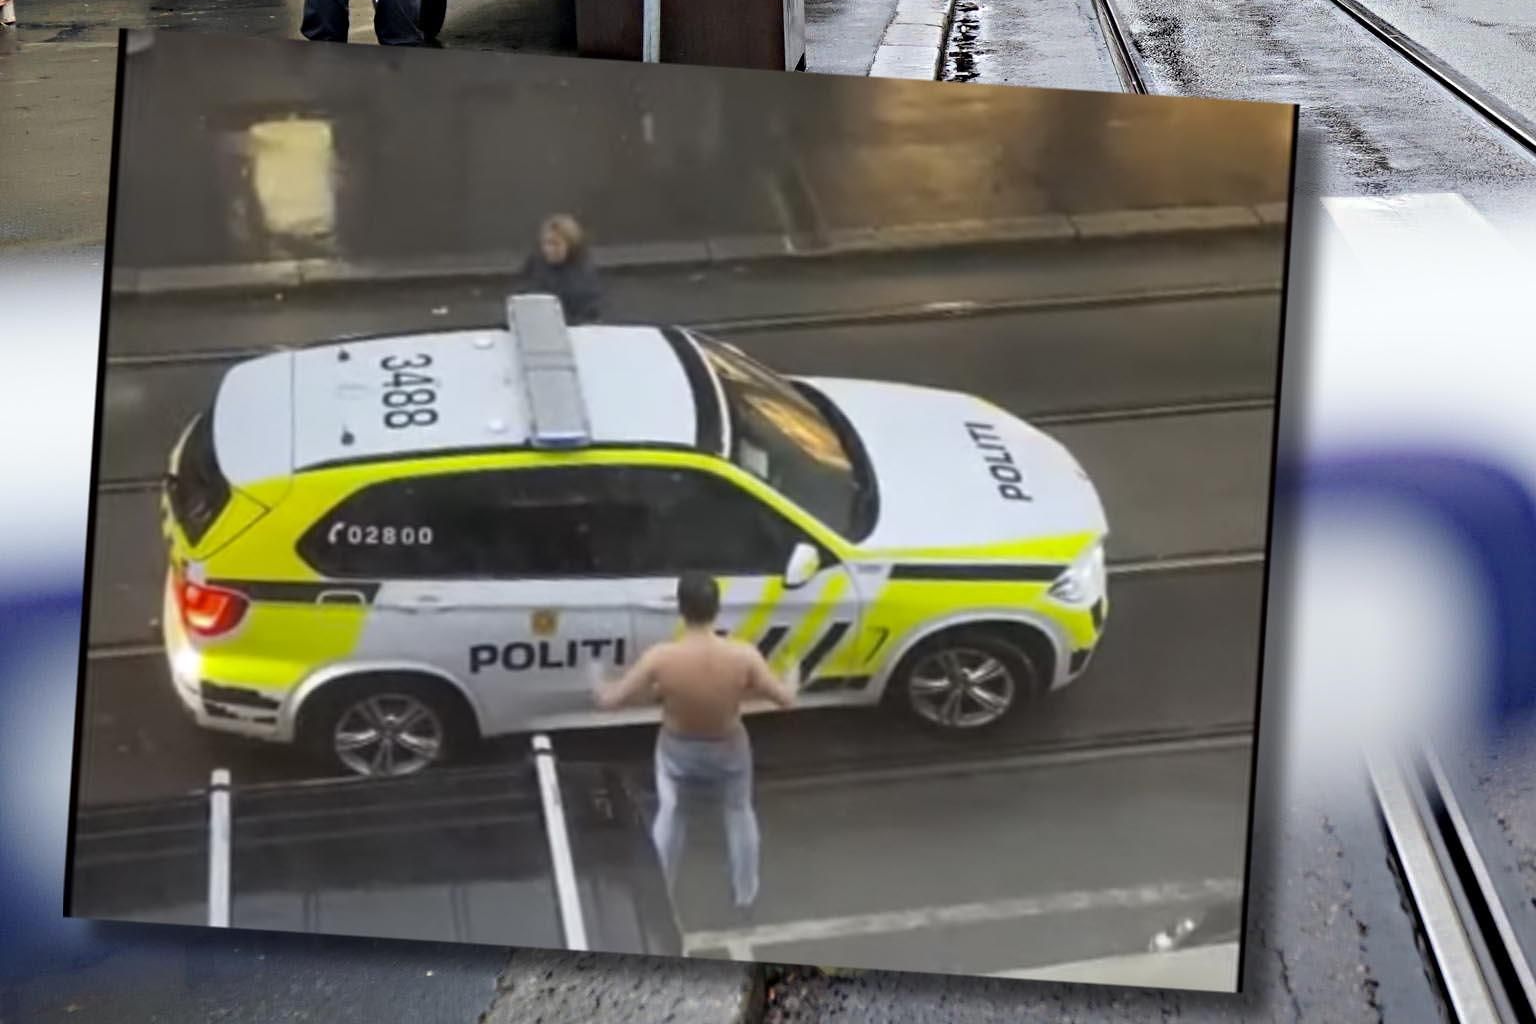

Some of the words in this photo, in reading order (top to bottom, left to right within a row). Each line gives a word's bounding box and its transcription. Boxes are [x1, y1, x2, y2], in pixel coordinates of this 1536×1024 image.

[381, 353, 439, 429] 3488
[963, 421, 1034, 503] POLITI
[347, 525, 434, 545] 02800
[469, 637, 626, 674] POLITI
